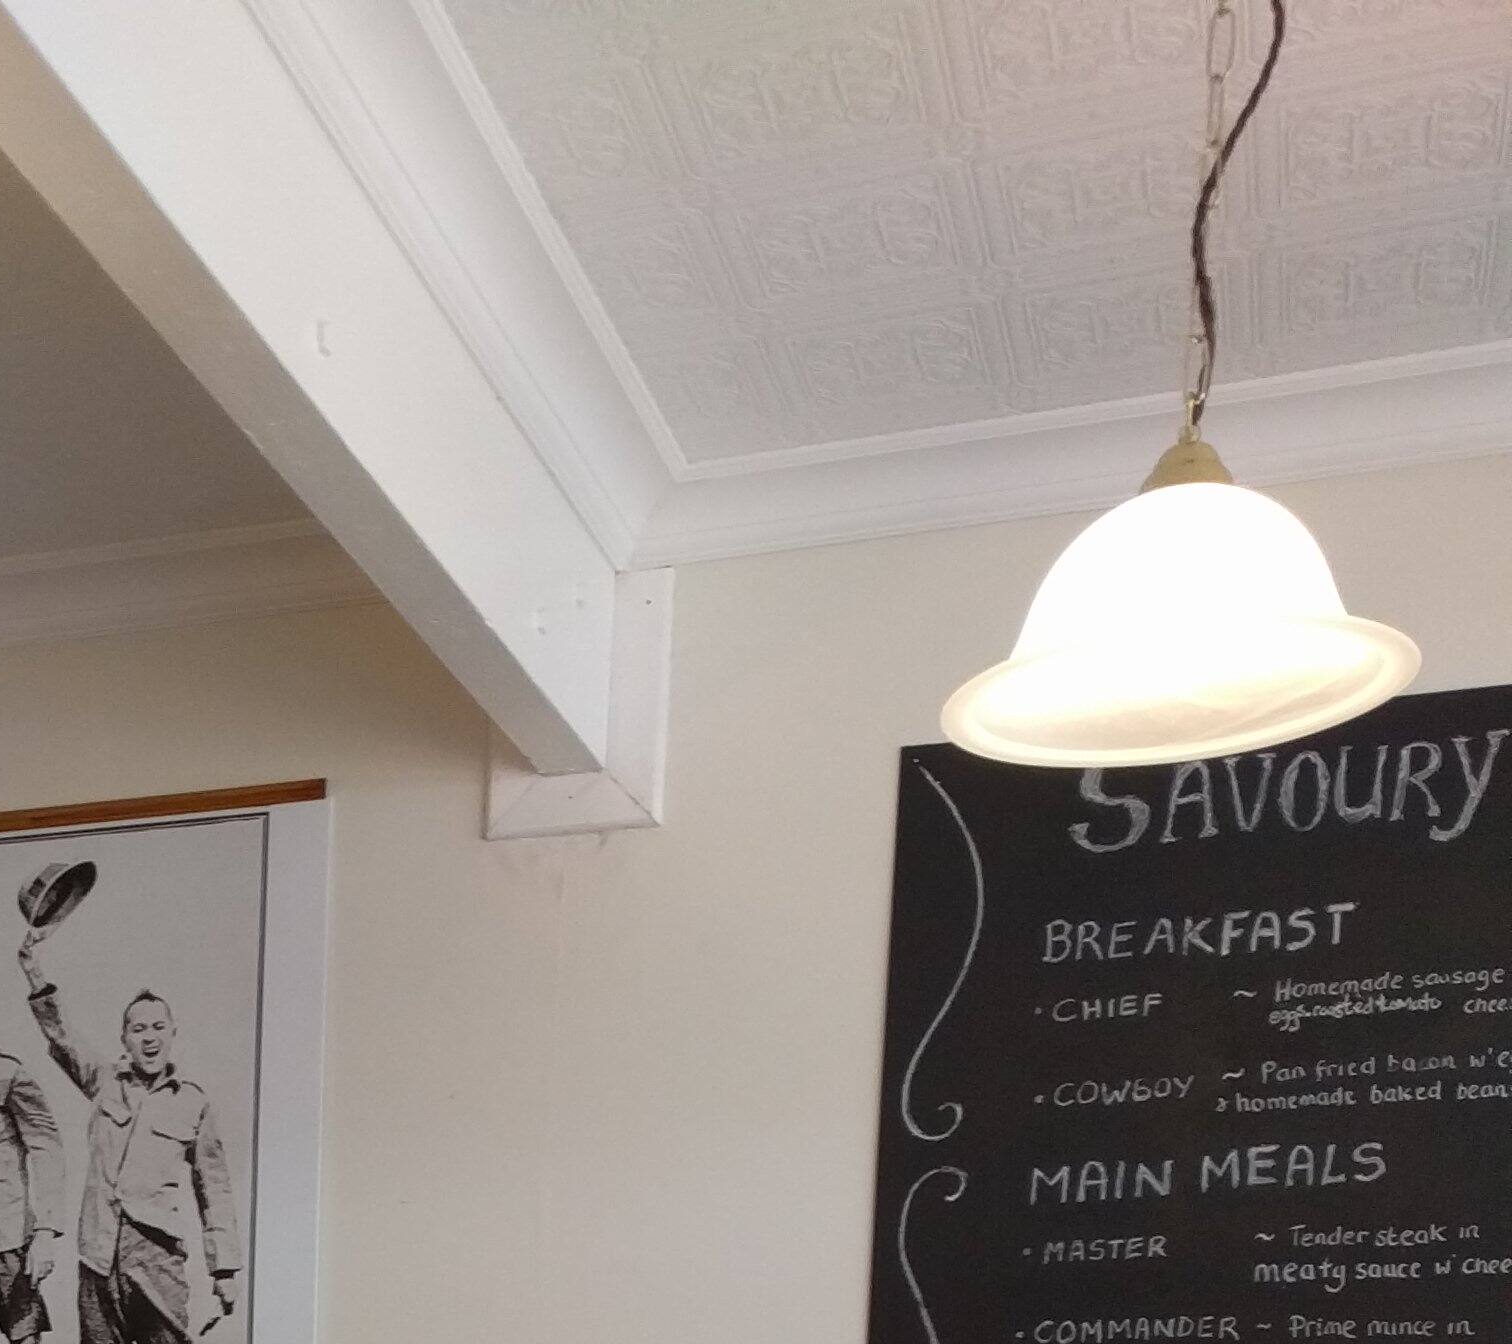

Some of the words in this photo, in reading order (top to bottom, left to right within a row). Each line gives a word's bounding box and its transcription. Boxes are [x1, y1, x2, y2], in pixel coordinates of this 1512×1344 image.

[1070, 730, 1510, 853] SAVOURY
[1041, 901, 1359, 963] BREAKFAST
[1051, 992, 1164, 1023] CHIEF
[1274, 972, 1404, 1001] Homemade
[1412, 968, 1506, 992] sausage
[1053, 1075, 1196, 1107] COWBOY
[1261, 1060, 1307, 1084] Pan
[1316, 1056, 1376, 1082] fried
[1370, 1080, 1442, 1105] baked
[1030, 1160, 1174, 1205] MAIN
[1201, 1142, 1387, 1193] MEALS
[1042, 1235, 1169, 1265] MASTER
[1289, 1225, 1370, 1246] Tender
[1375, 1224, 1448, 1247] steak
[1459, 1225, 1480, 1239] in
[1254, 1258, 1346, 1293] meaty
[1355, 1261, 1422, 1280] sauce
[1289, 1315, 1357, 1339] Prime
[1367, 1320, 1436, 1337] mince
[1447, 1320, 1476, 1335] in
